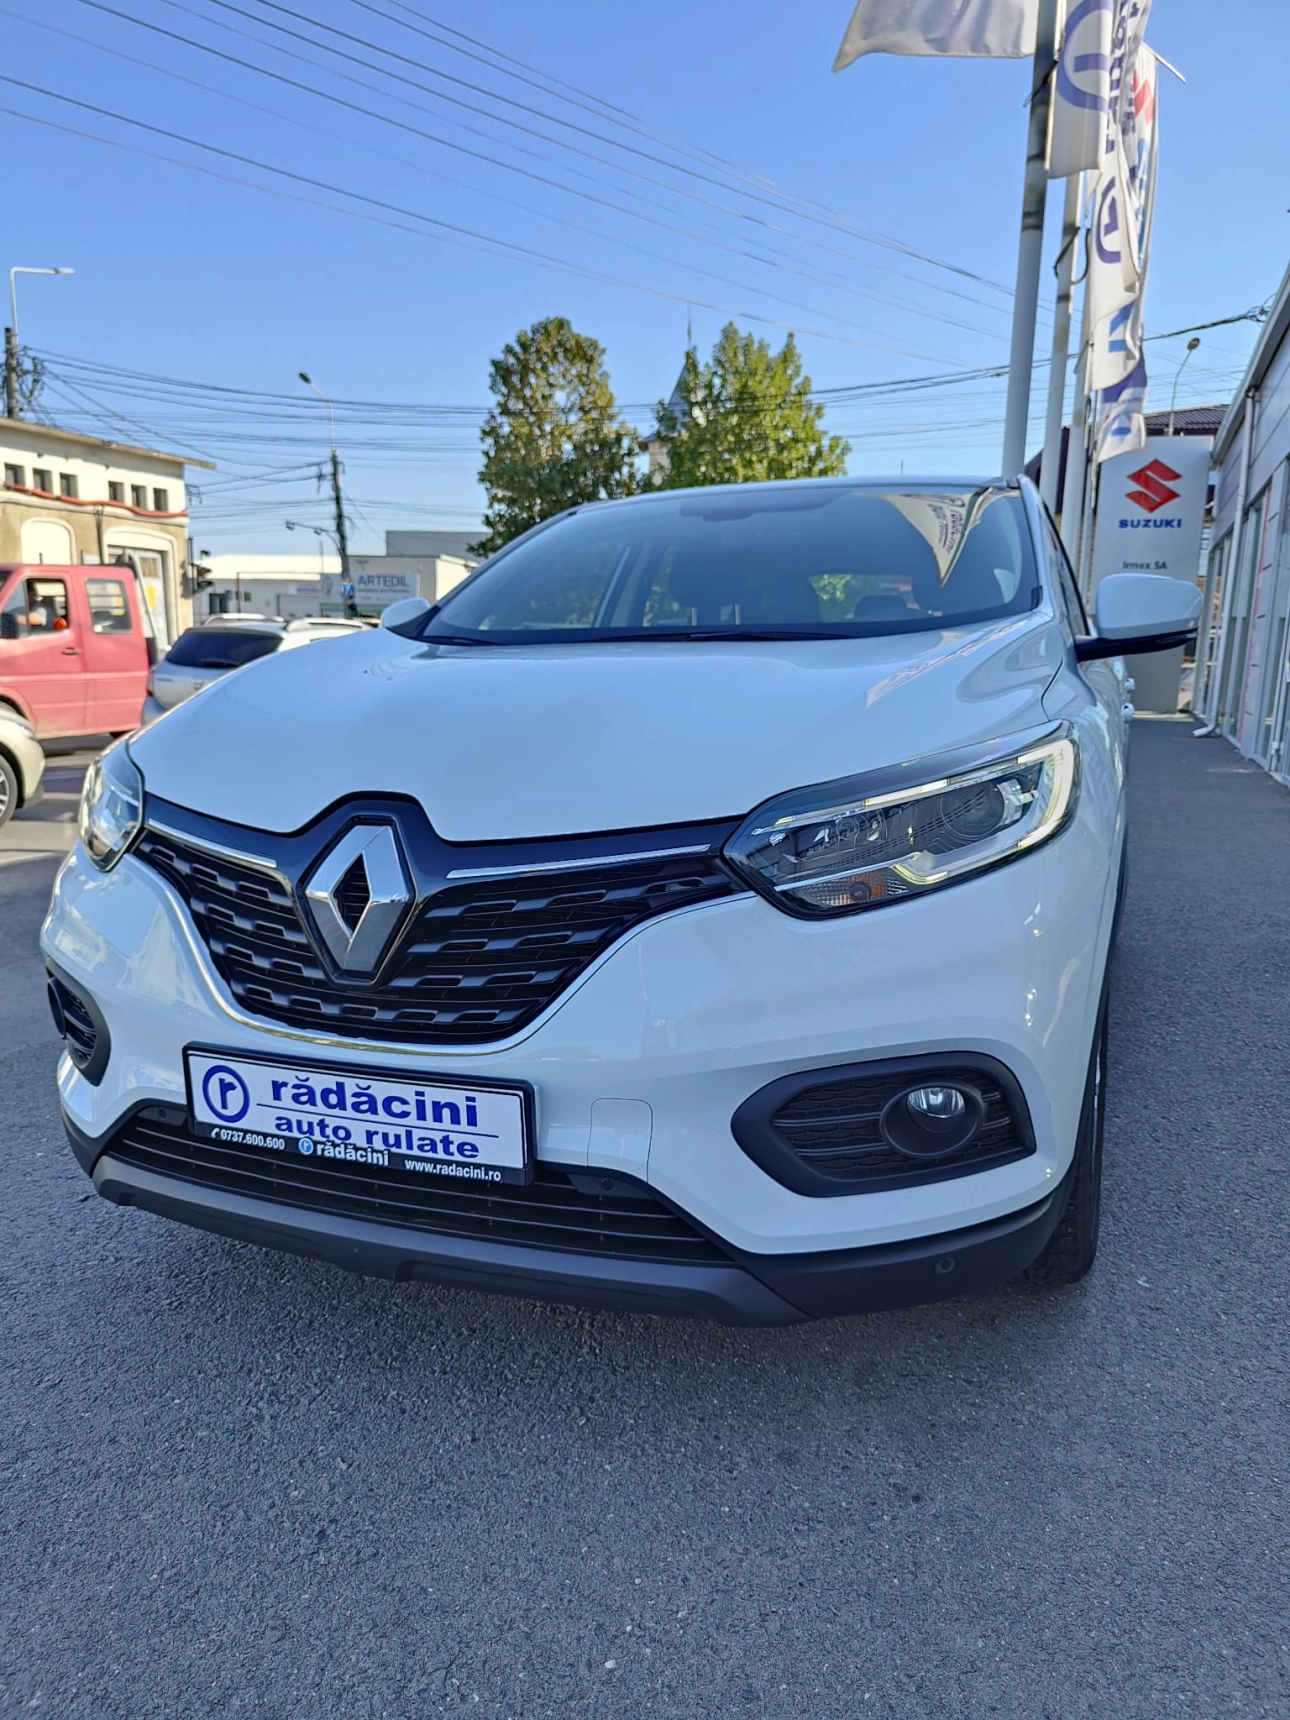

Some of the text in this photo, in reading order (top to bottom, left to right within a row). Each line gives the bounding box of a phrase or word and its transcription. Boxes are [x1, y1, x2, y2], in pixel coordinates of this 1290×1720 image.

[1118, 518, 1182, 529] SUZUKI
[1122, 561, 1167, 570] Irmex SA
[358, 573, 410, 587] ARTEDIL
[271, 1075, 478, 1127] rădăcini
[220, 1128, 285, 1150] 0737.600.600
[275, 1116, 480, 1159] auto rulate
[316, 1141, 389, 1166] rădăcini
[404, 1158, 502, 1182] www.radacini.ro
